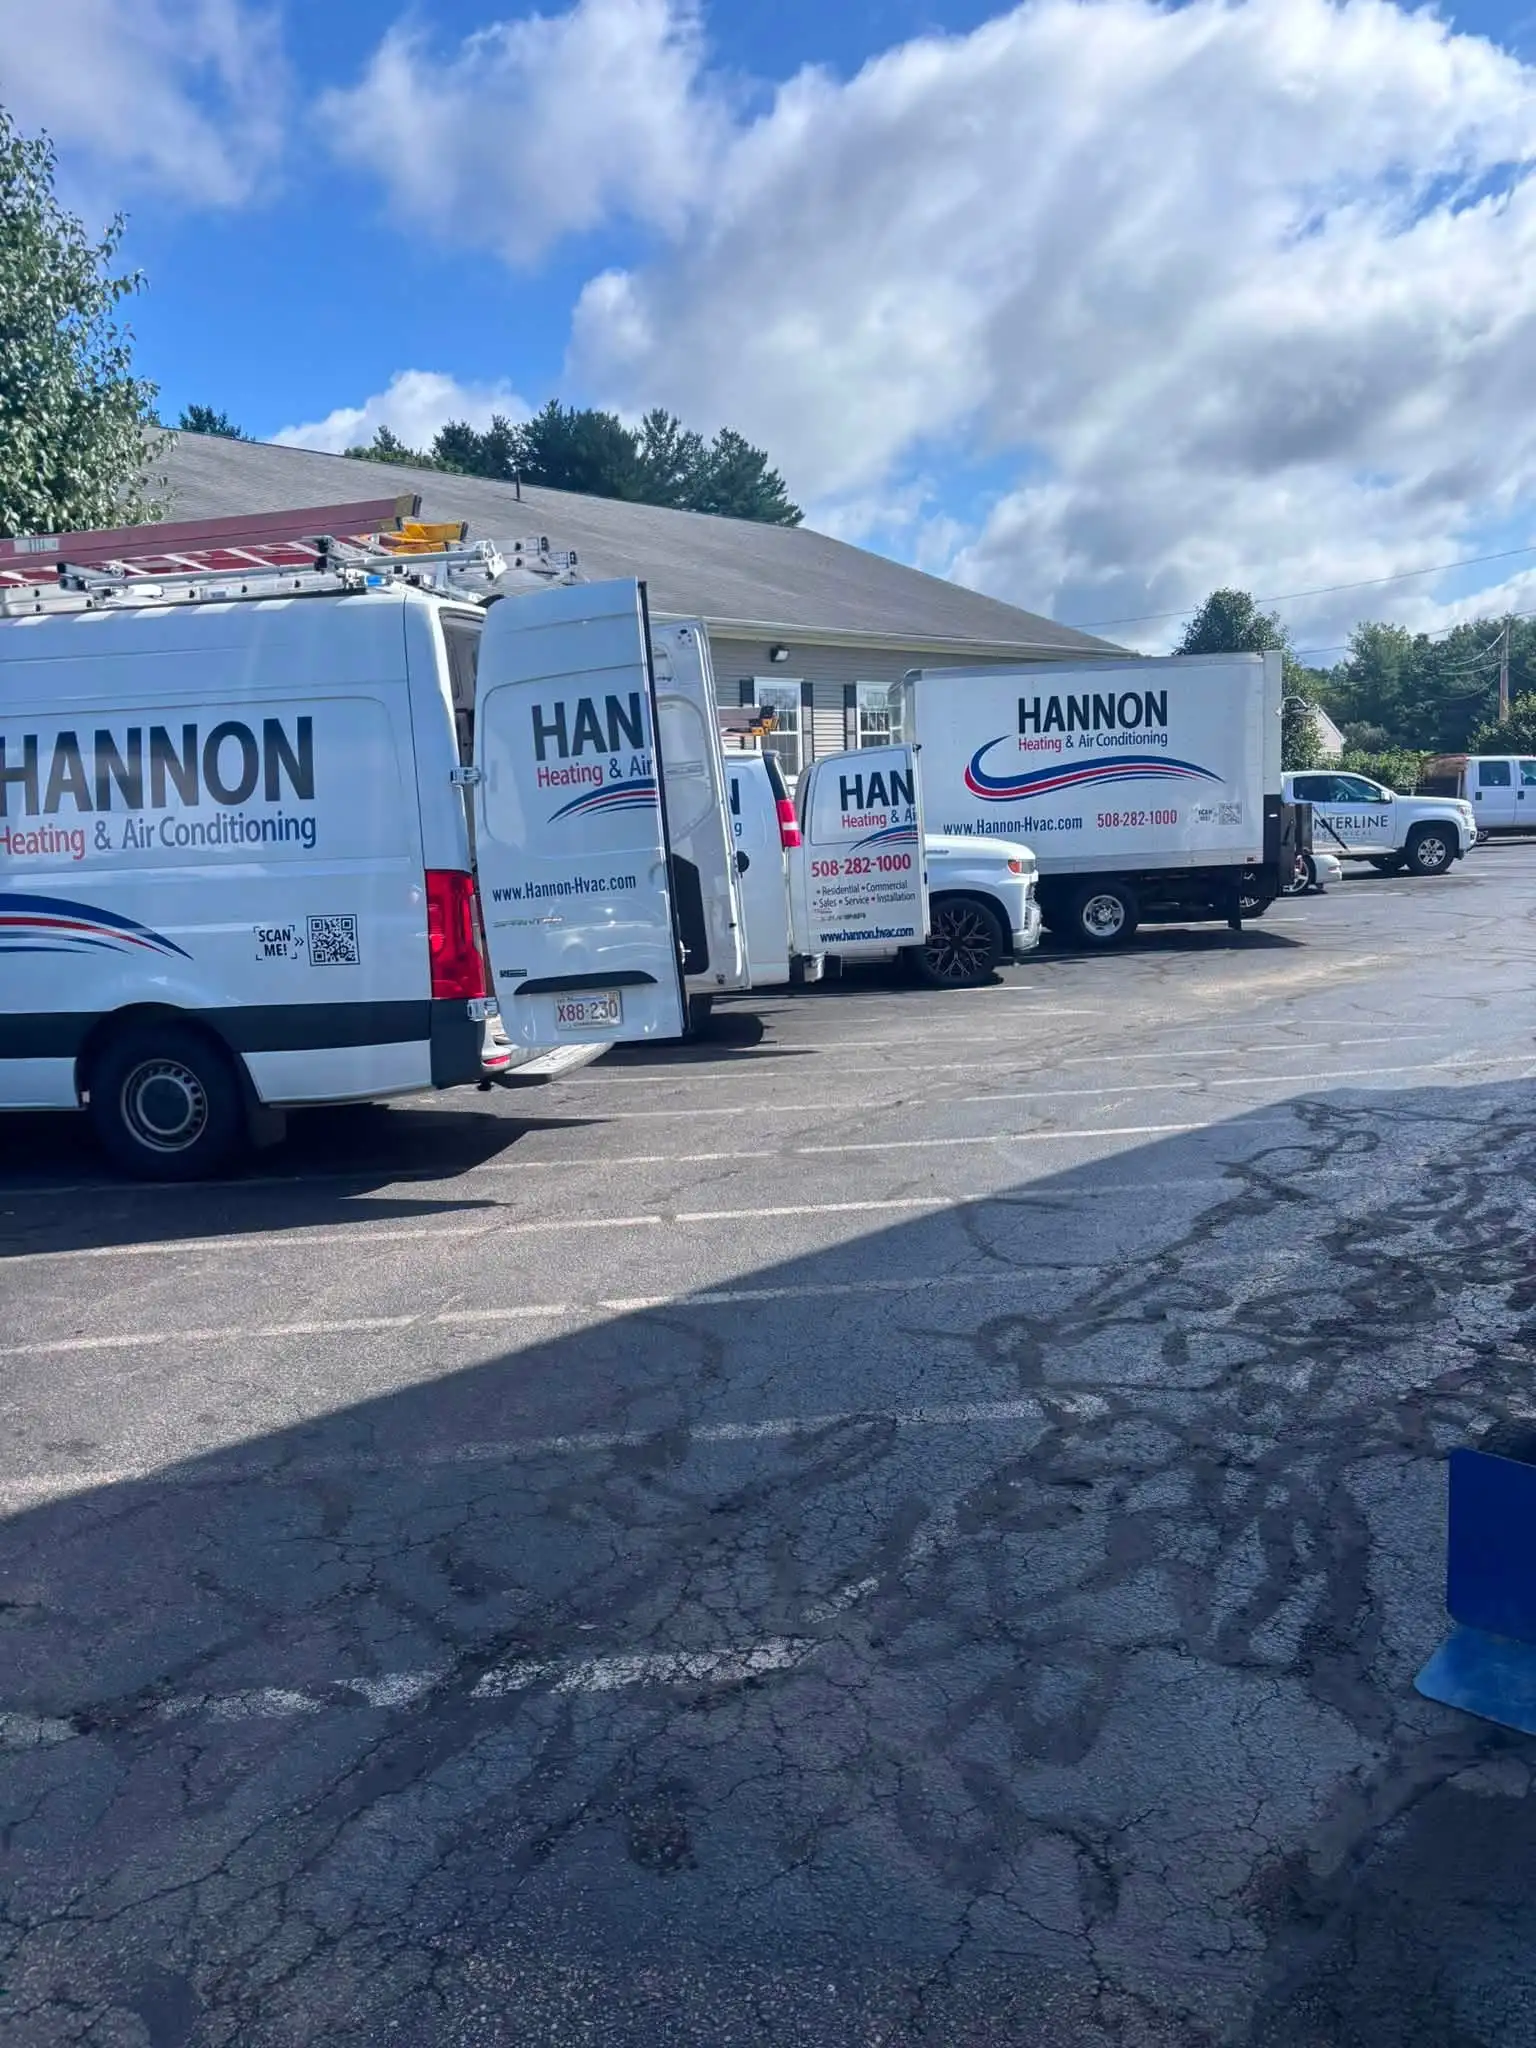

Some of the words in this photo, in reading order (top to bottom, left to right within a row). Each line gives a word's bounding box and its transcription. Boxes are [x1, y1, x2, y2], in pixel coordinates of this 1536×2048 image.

[1018, 690, 1168, 734] HANNON
[531, 692, 644, 761] HAN
[1018, 737, 1062, 752] Heating
[1065, 734, 1074, 748] &
[1078, 732, 1094, 748] Air
[1096, 730, 1168, 747] Conditioning
[0, 716, 315, 817] HANNON
[537, 762, 603, 788] Heating
[609, 757, 622, 779] &
[839, 768, 915, 812] HAN
[841, 812, 887, 829] Heating
[890, 809, 899, 823] &
[943, 816, 1083, 836] www.Hannon-Hvac.com
[1096, 809, 1178, 828] 508-282-1000
[1313, 814, 1389, 830] NTERLINE
[0, 823, 86, 860] Heating
[93, 820, 112, 850] &
[121, 818, 155, 850] Air
[159, 810, 316, 849] Conditioning
[811, 853, 912, 878] 508-282-1000
[492, 875, 637, 902] www.Hannon-Hvac.com
[822, 883, 860, 896] Residential
[865, 879, 908, 892] Commercial
[819, 898, 837, 908] Sales
[844, 895, 869, 906] Service
[258, 929, 291, 942] SCAN
[264, 943, 288, 956] ME!
